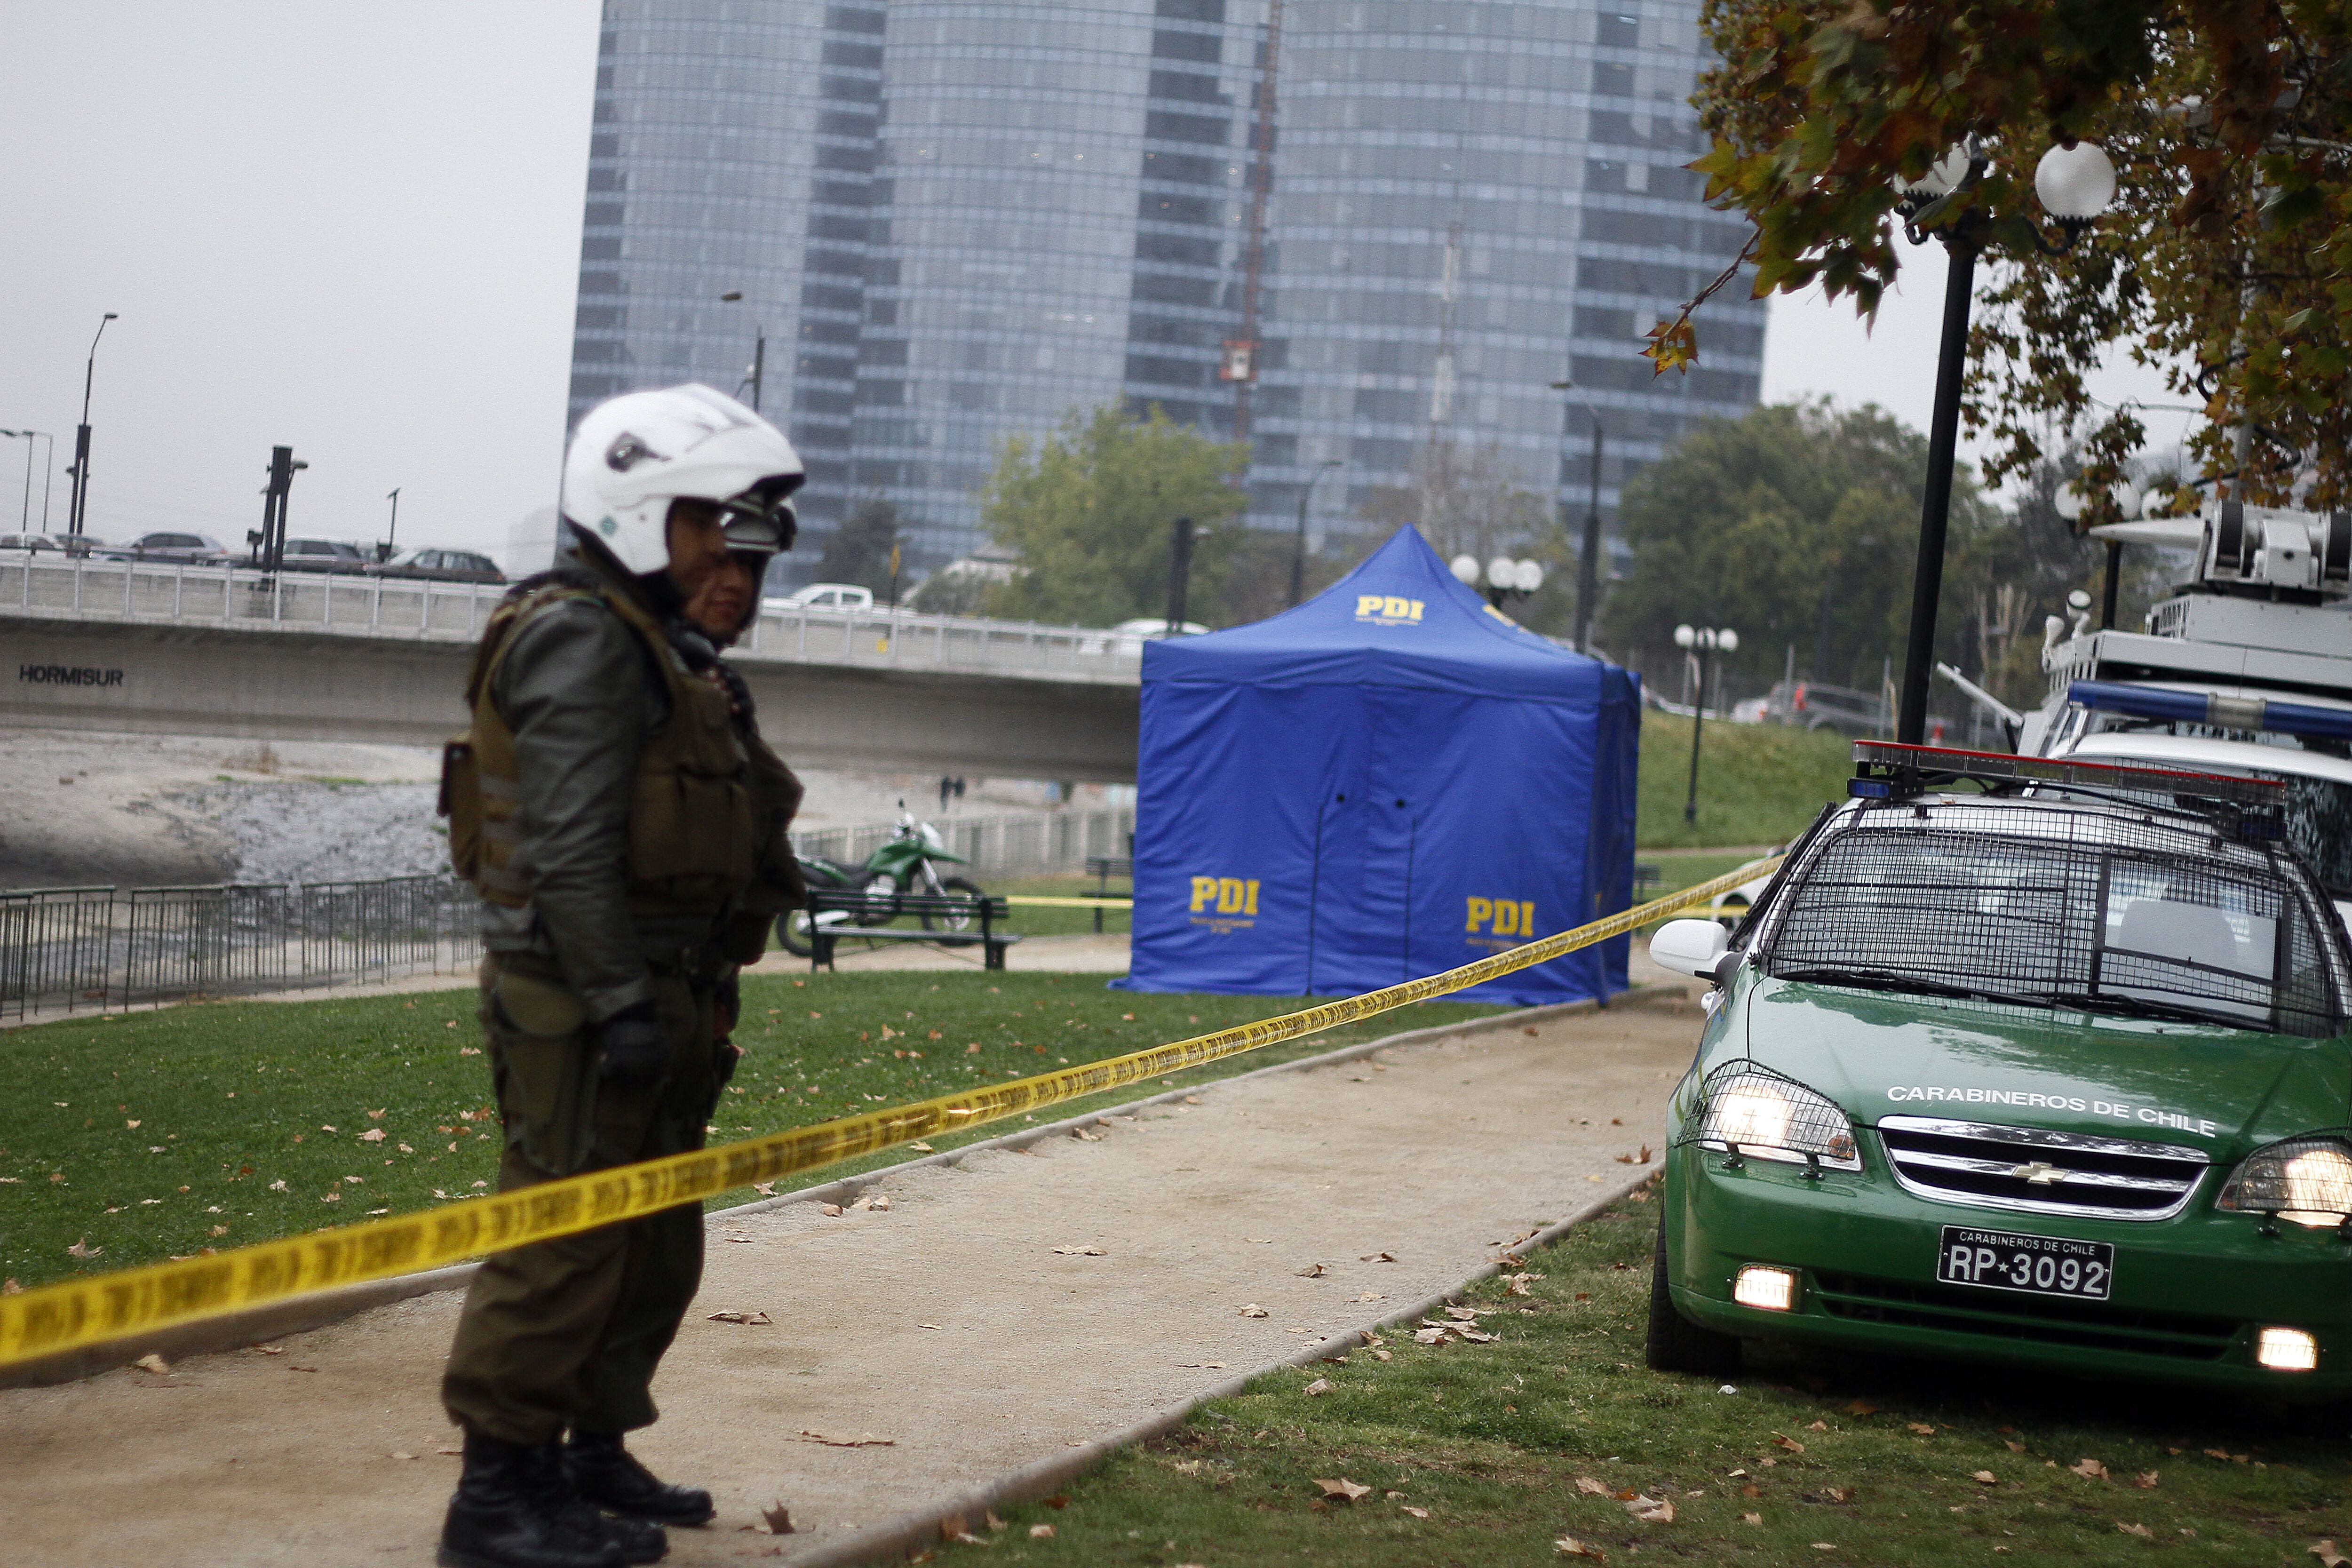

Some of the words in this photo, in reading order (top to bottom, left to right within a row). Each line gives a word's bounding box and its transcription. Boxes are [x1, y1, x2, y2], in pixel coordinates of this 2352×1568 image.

[1355, 596, 1424, 620] PDI
[19, 665, 123, 686] HORMISUR
[1190, 876, 1260, 915] PDI
[1466, 897, 1534, 937] PDI
[1887, 1086, 2086, 1112] CARABINEROS
[2094, 1101, 2130, 1118] DE
[2138, 1108, 2216, 1138] CHILE
[1960, 1231, 2039, 1250] CARABINEROS
[2044, 1242, 2058, 1252] DE
[2063, 1243, 2095, 1256] CHILE
